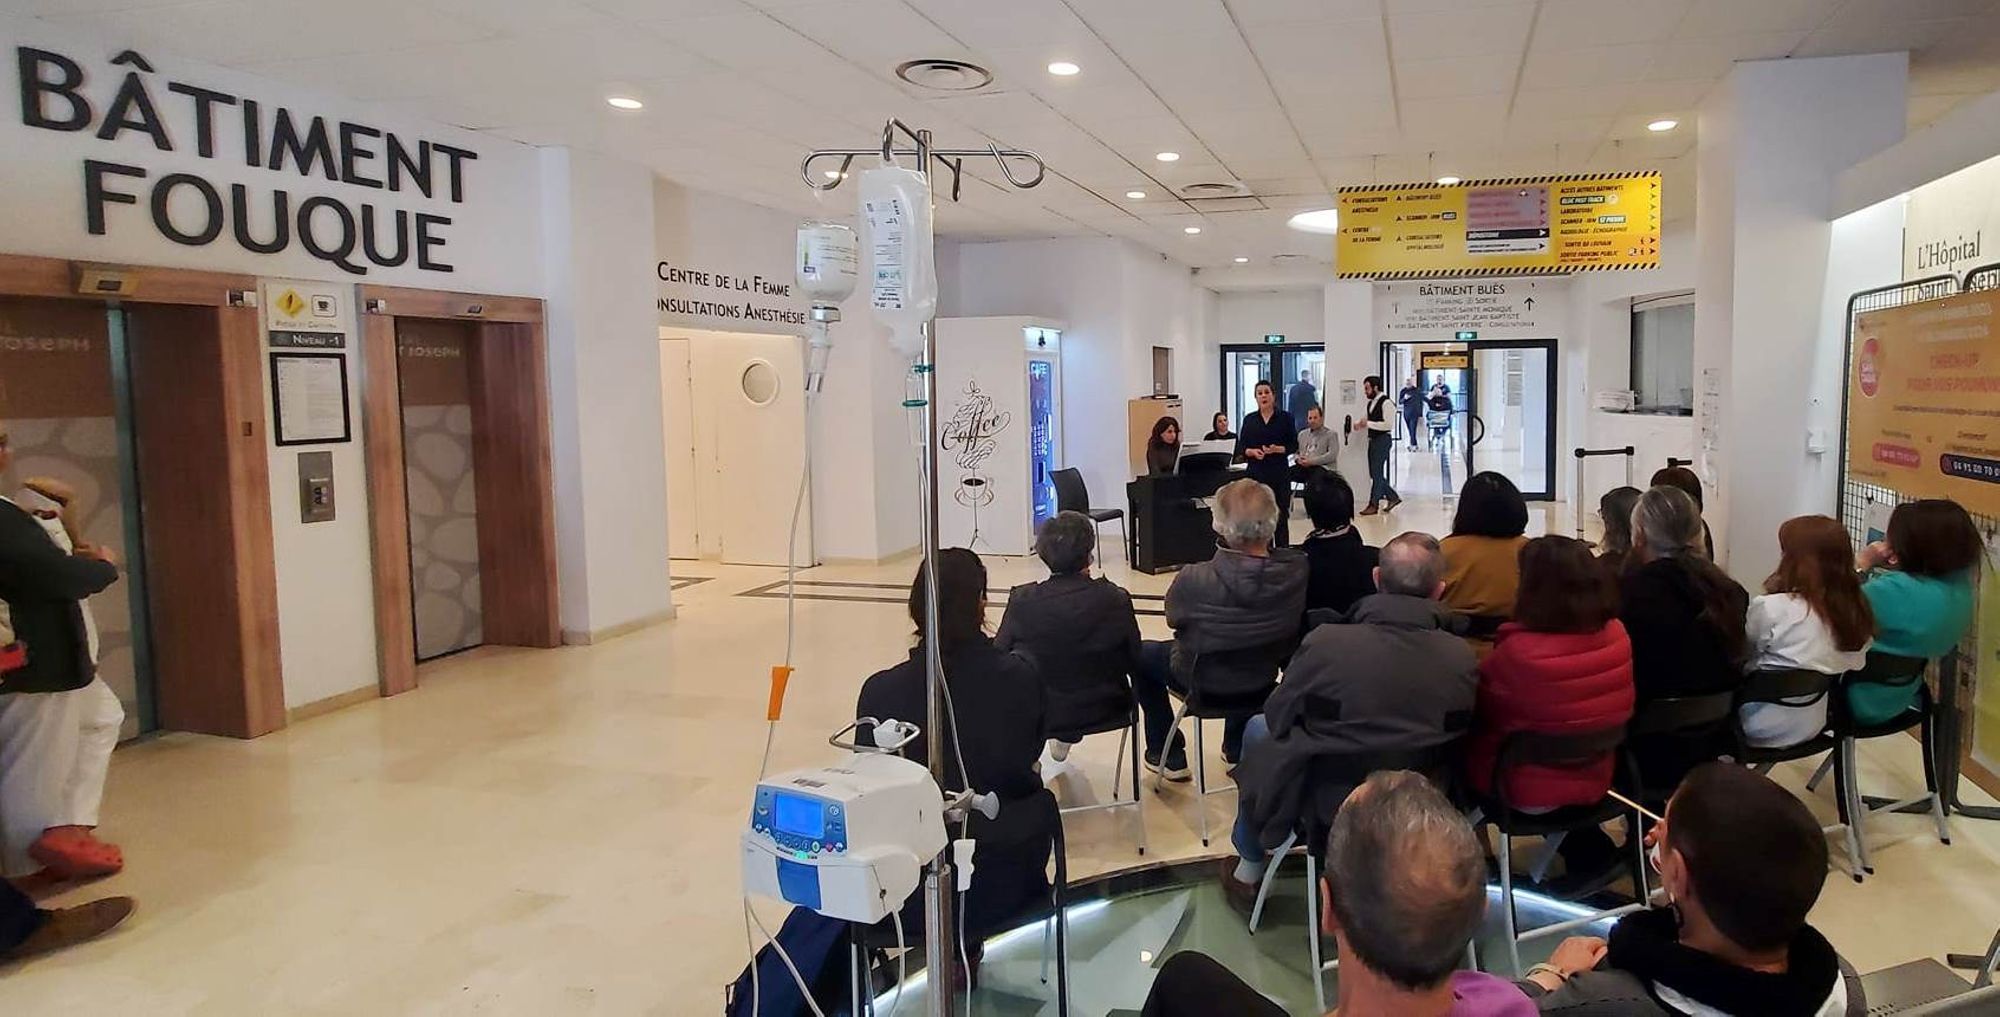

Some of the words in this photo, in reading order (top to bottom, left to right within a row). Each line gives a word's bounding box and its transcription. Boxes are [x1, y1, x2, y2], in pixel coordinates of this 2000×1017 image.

[18, 46, 478, 203] BÂTIMENT
[85, 159, 454, 275] FOUQUE
[1918, 229, 1980, 271] L'Hôpital
[657, 261, 710, 287] CENTRE
[715, 275, 730, 289] DE
[735, 277, 749, 292] LA
[754, 276, 790, 297] FEMME
[1419, 284, 1474, 296] BÂTIMENT
[744, 303, 806, 325] ANESTHÉSIE
[941, 396, 1005, 453] Coffee
